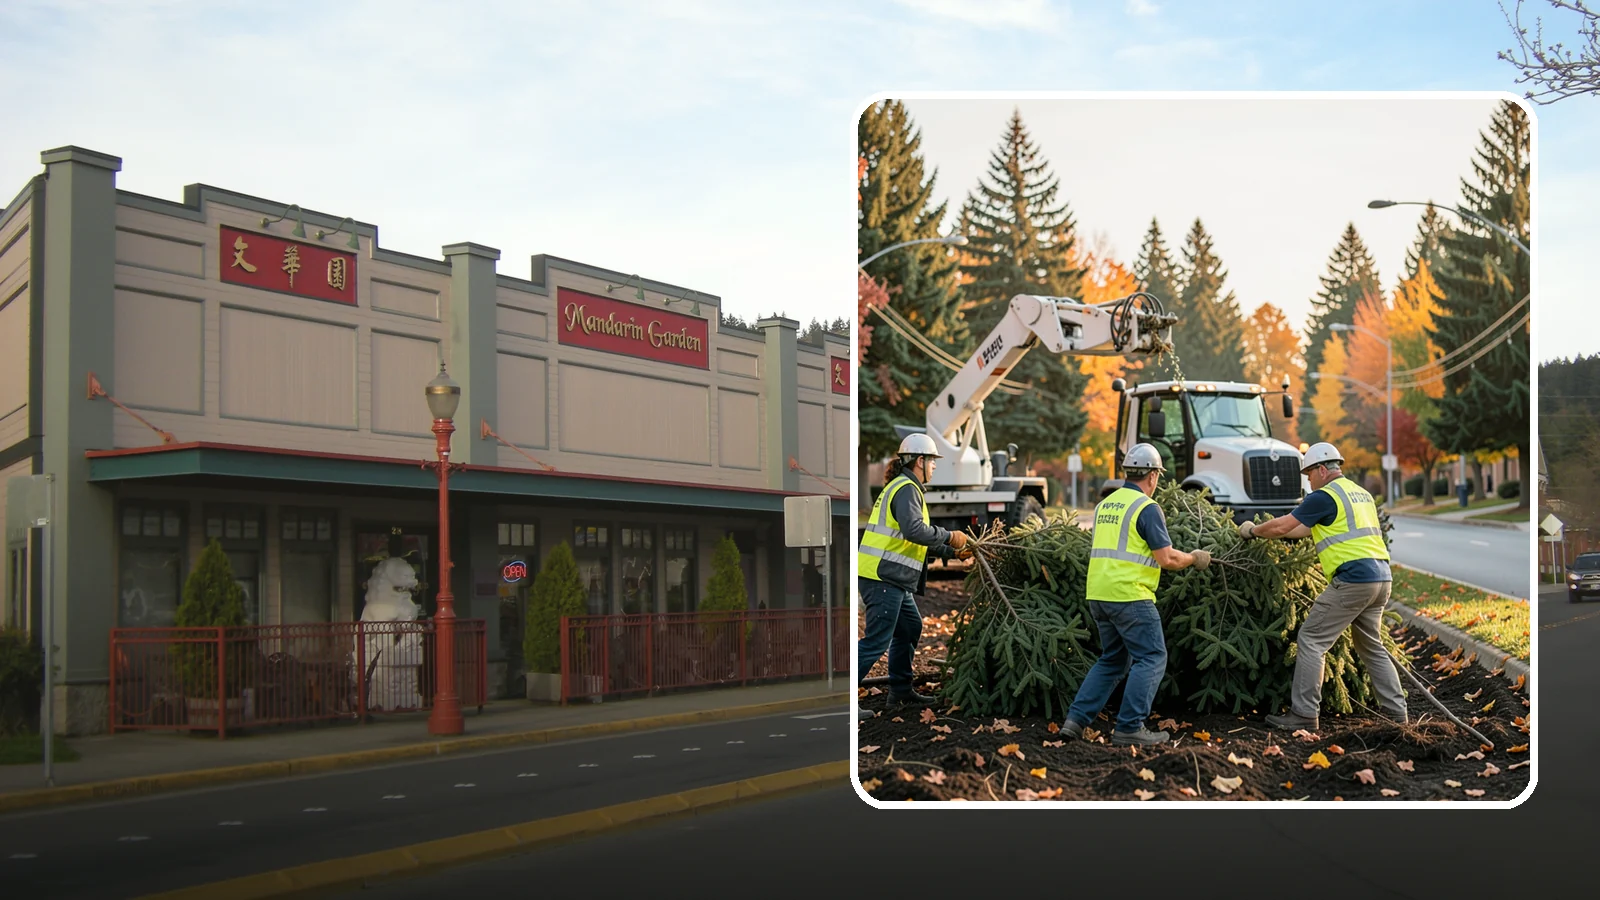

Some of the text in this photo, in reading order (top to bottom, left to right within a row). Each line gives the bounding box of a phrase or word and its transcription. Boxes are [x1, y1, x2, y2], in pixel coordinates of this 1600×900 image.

[230, 235, 346, 291] 文華園
[564, 302, 702, 352] Mandarin Garden
[503, 565, 527, 578] OPEN
